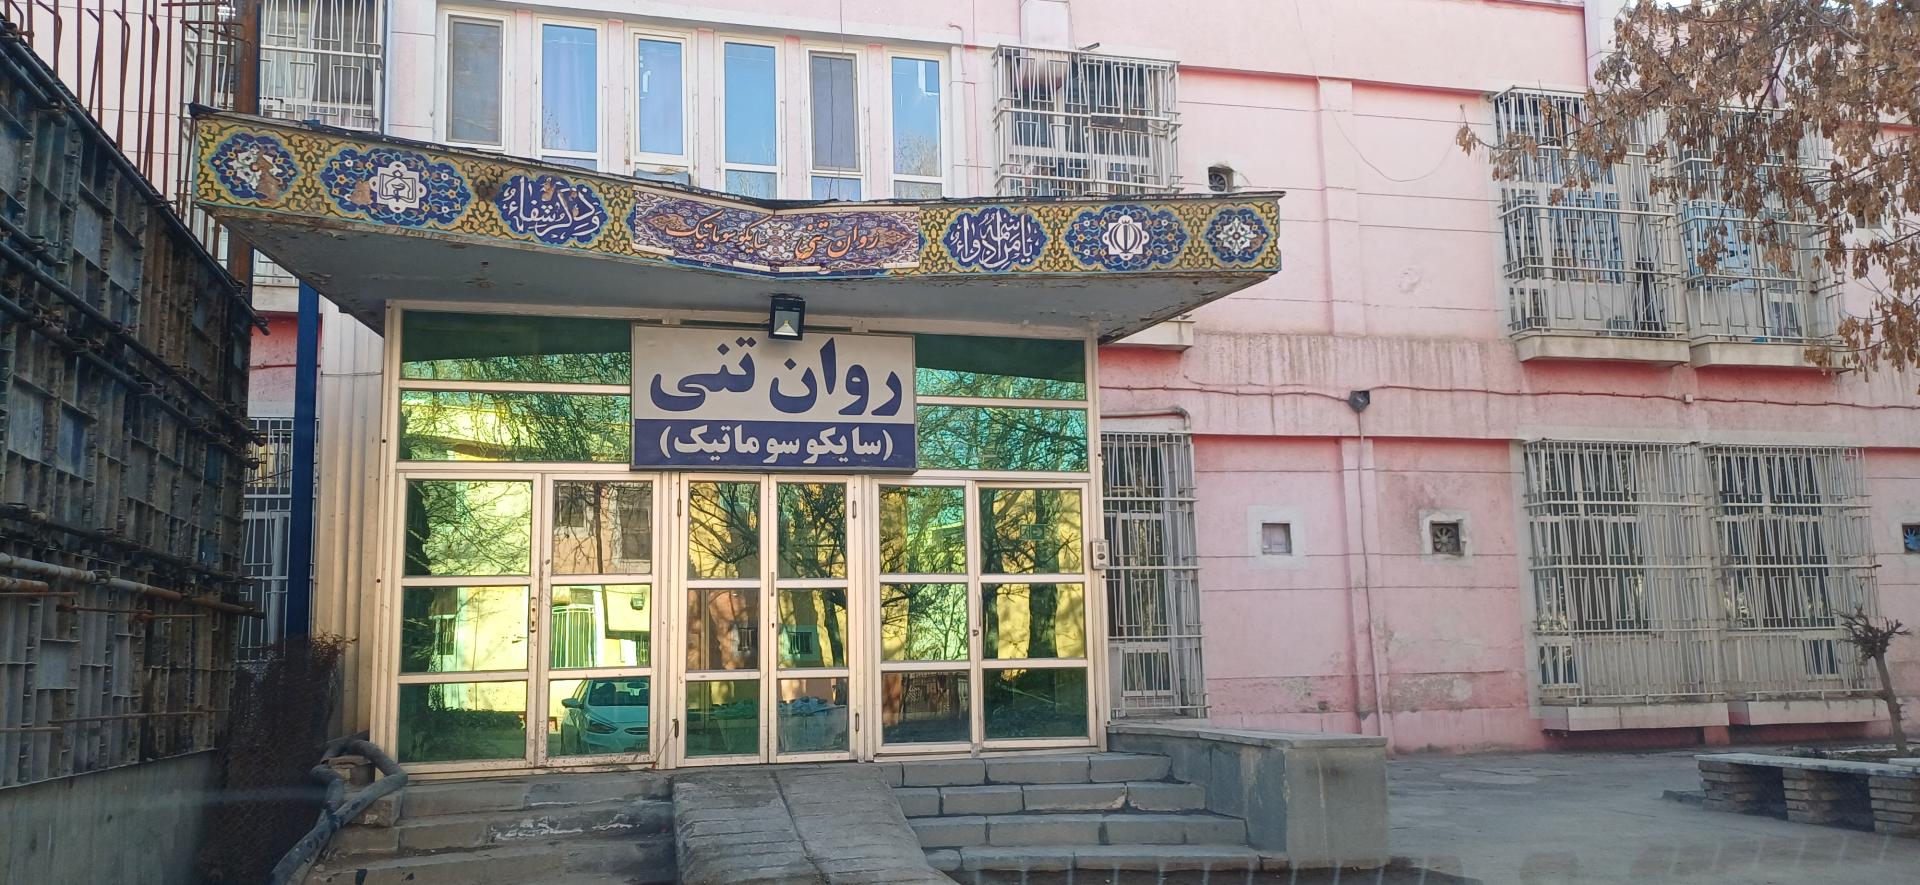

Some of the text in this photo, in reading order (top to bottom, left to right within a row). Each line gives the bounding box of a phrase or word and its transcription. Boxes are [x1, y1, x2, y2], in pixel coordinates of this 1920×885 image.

[794, 219, 829, 260] تنی
[826, 225, 880, 259] روان
[650, 336, 903, 417] روان تنی
